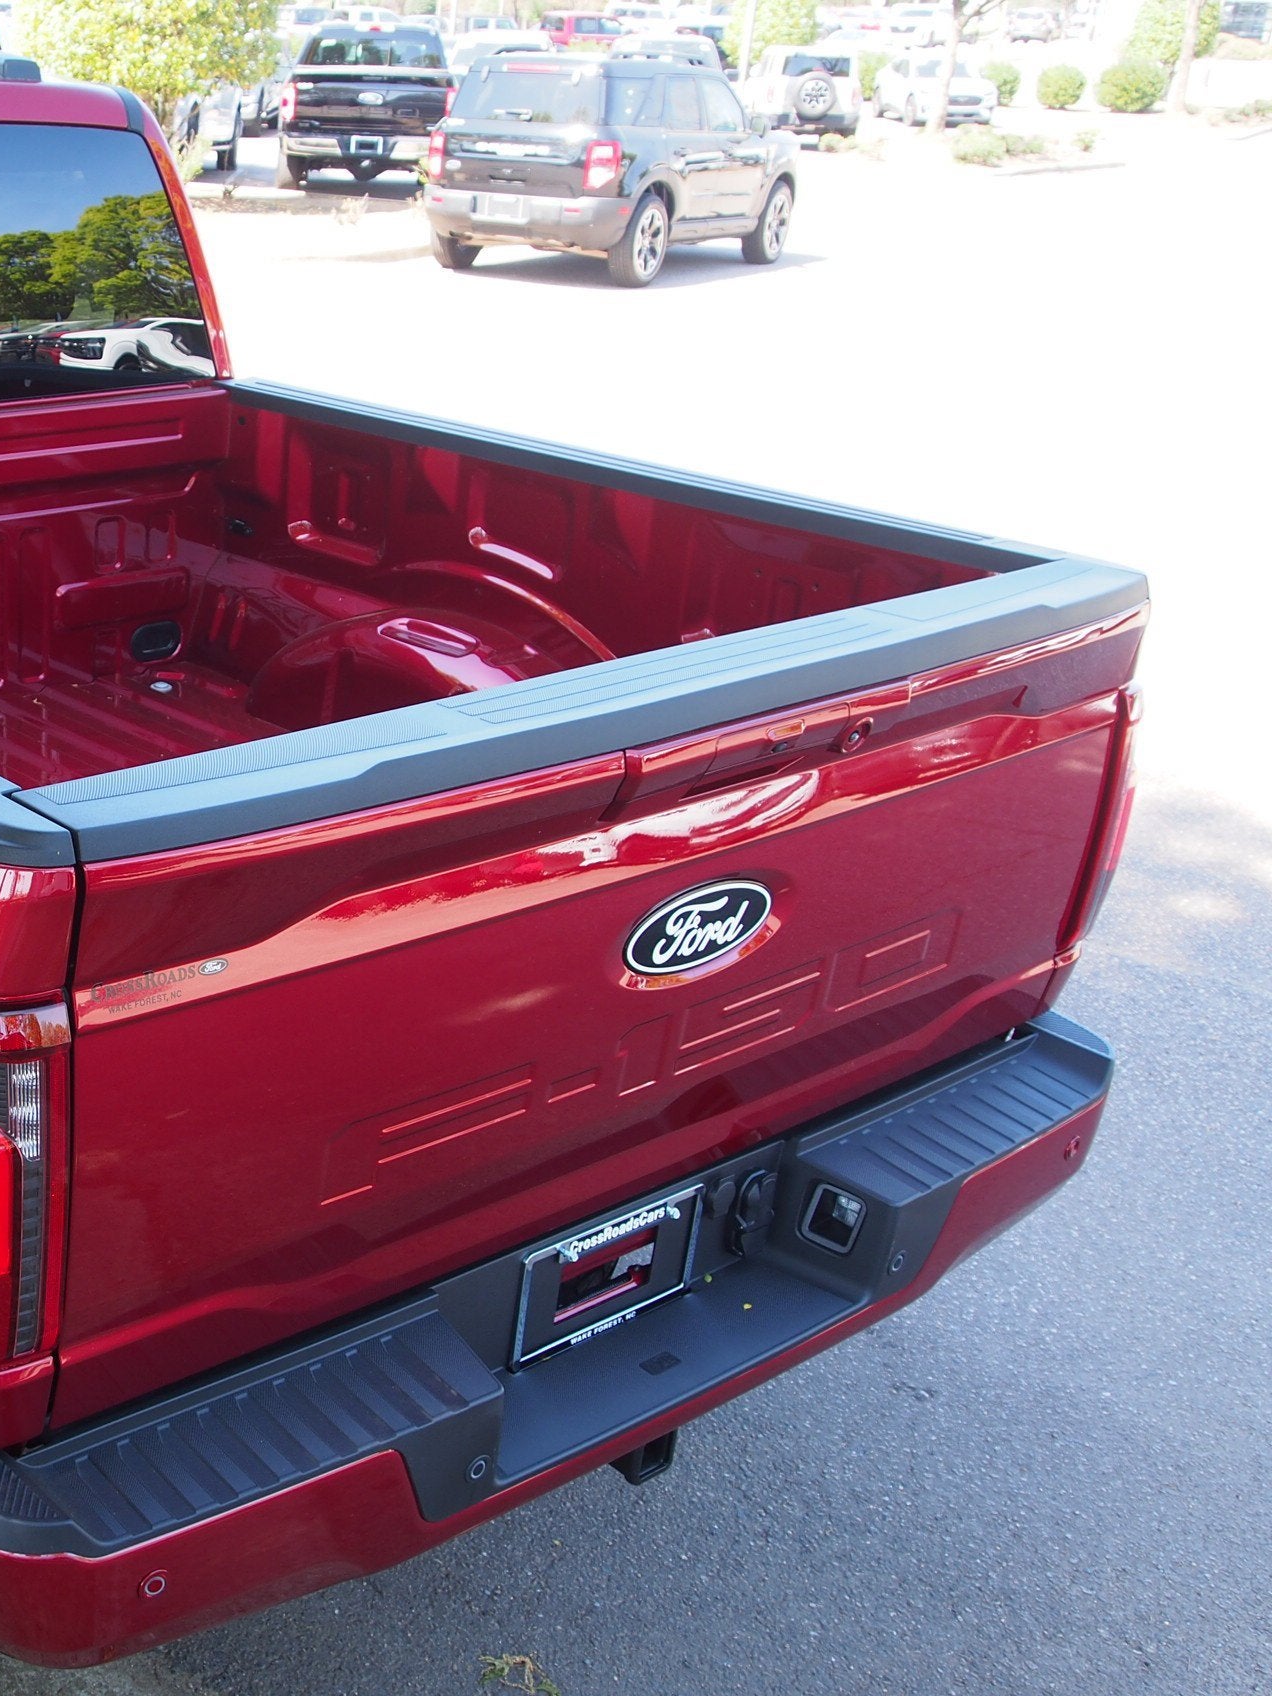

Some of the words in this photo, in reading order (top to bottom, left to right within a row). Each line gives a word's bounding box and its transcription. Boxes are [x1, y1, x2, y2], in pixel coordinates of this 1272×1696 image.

[650, 893, 751, 967] Ford
[201, 958, 225, 974] Ford
[108, 1003, 133, 1014] WAKE
[134, 994, 168, 1008] FOREST,
[170, 989, 182, 999] NC
[322, 909, 959, 1206] F-150
[569, 1207, 666, 1253] CrossRoadsCars
[570, 1331, 592, 1345] WAKE
[625, 1311, 637, 1321] NC
